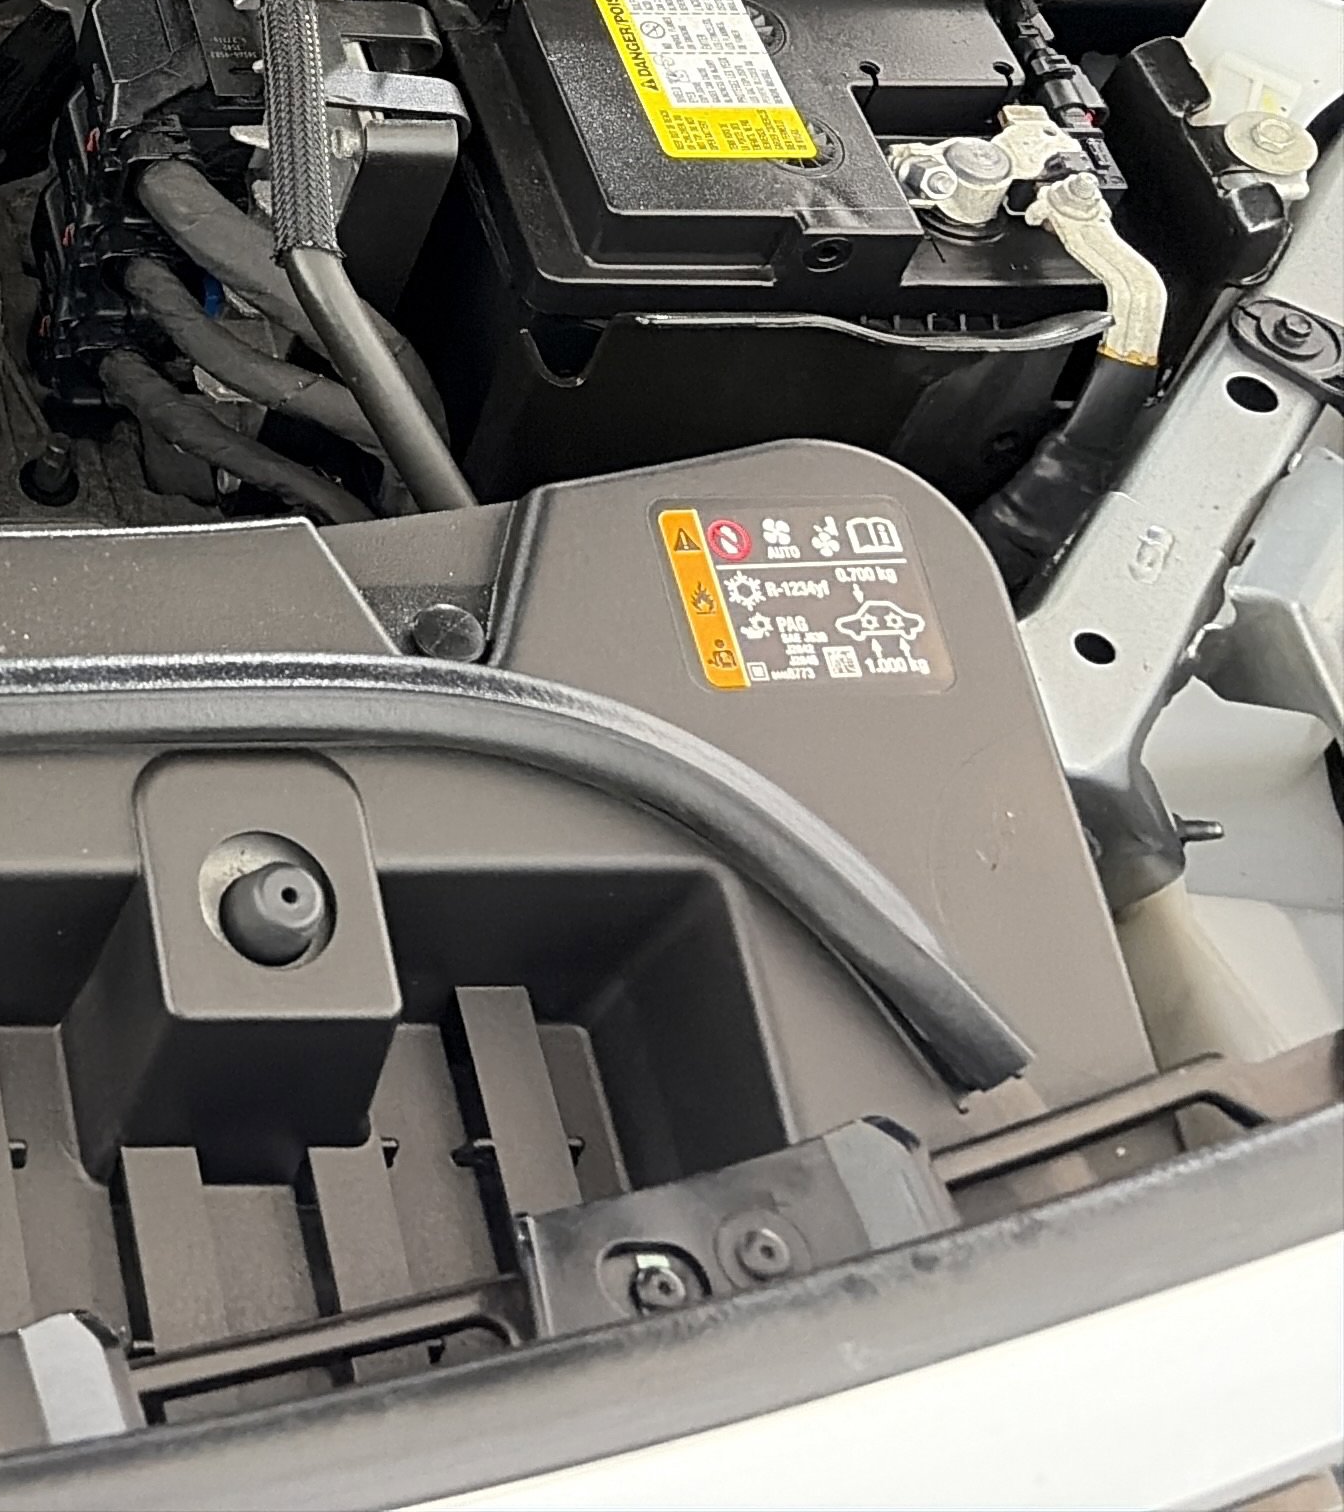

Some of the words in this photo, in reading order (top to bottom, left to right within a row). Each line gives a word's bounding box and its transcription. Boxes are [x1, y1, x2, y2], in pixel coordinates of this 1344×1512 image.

[767, 545, 801, 559] AUTO
[834, 566, 877, 583] 0.700
[874, 565, 899, 585] kg
[764, 579, 831, 599] R-1234yf
[775, 615, 810, 633] PAG
[864, 656, 908, 674] 1.000
[907, 656, 931, 675] kg
